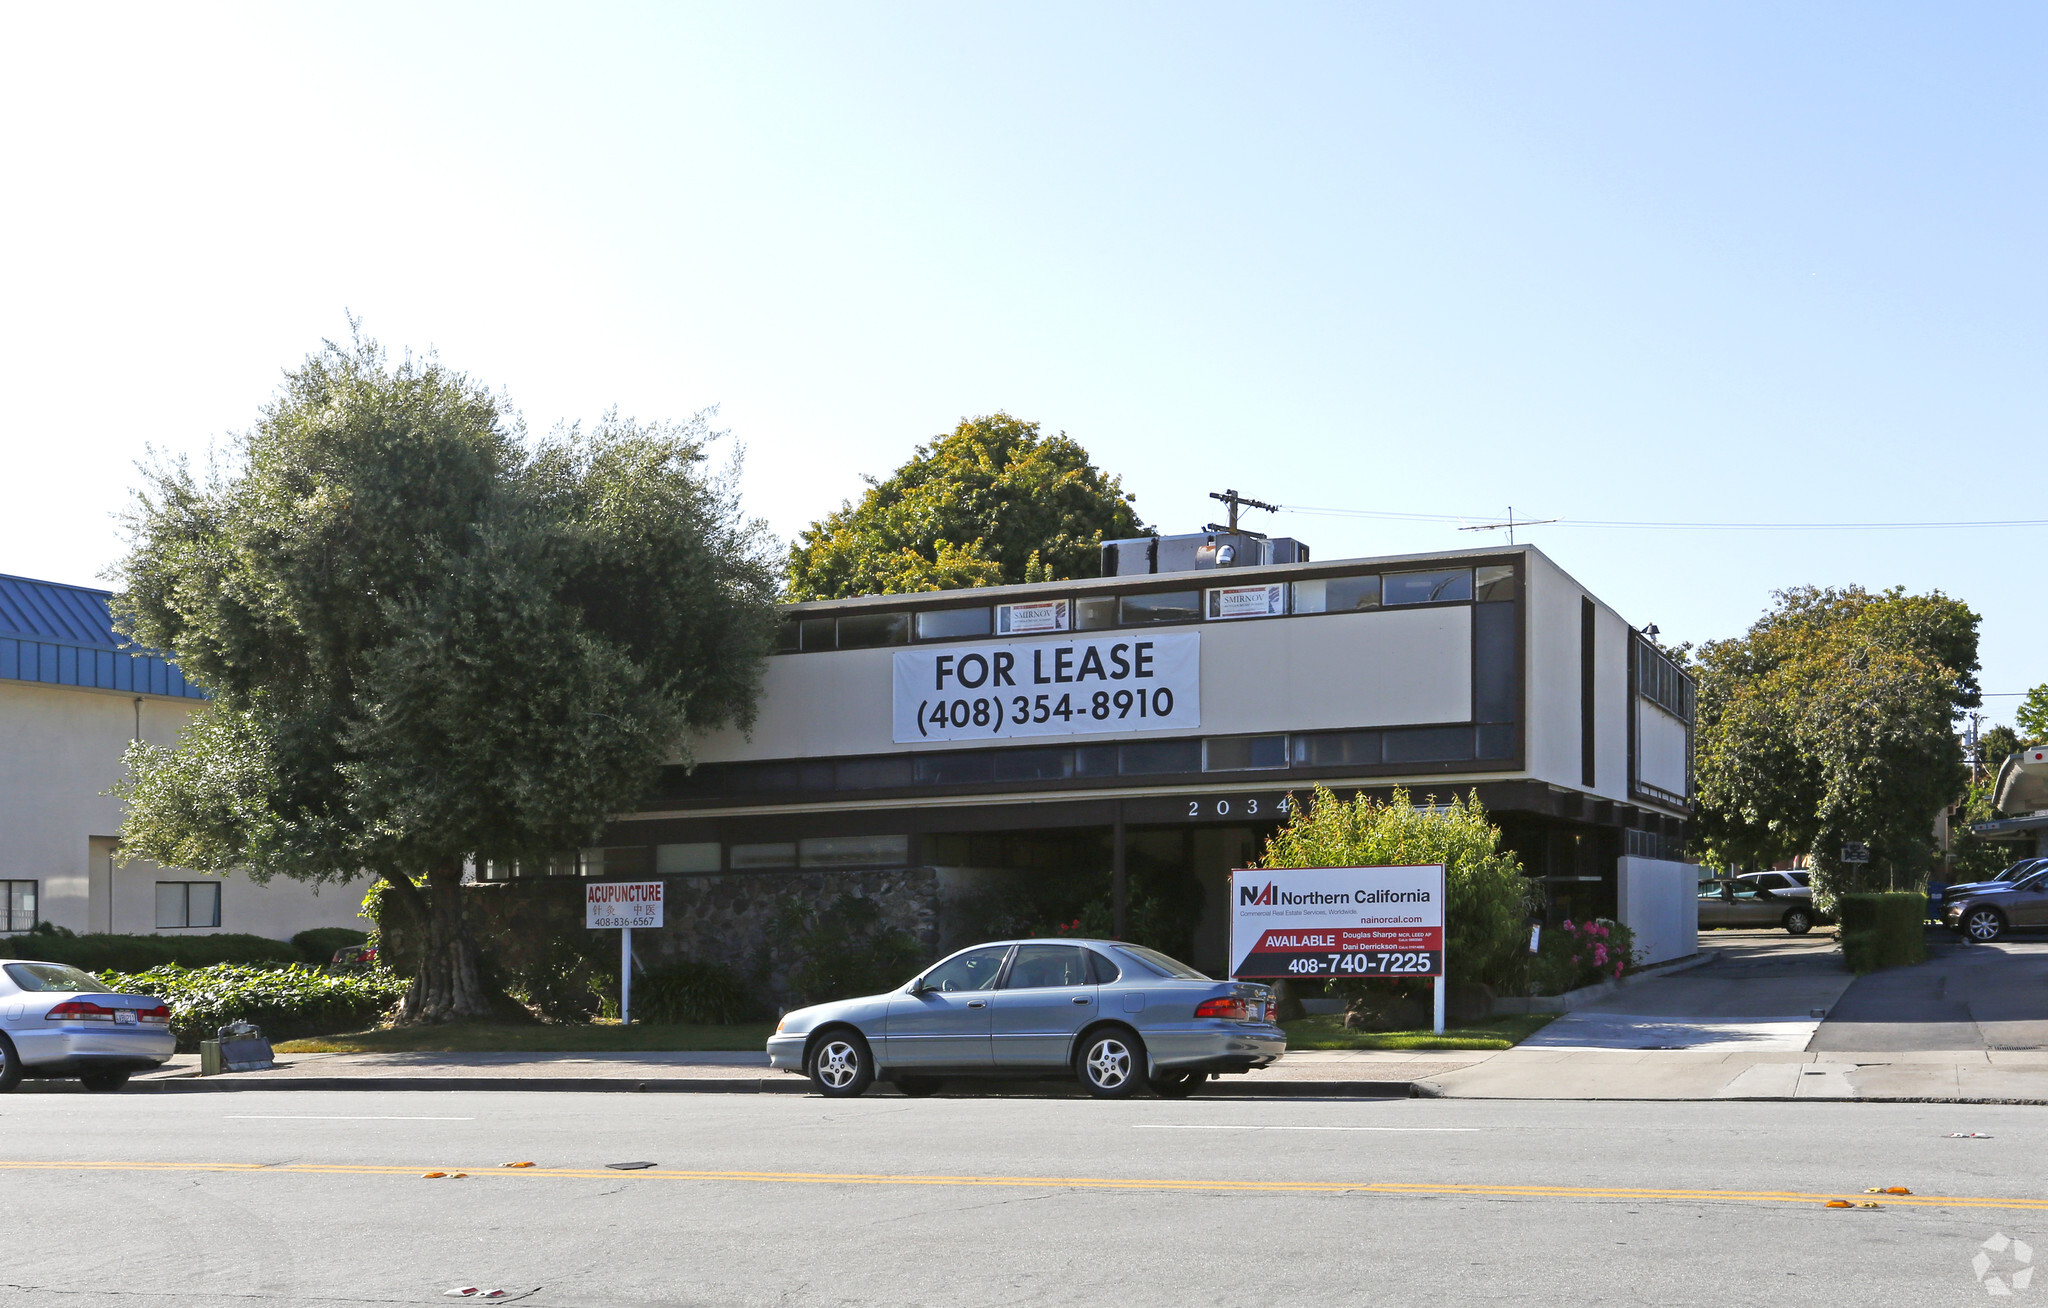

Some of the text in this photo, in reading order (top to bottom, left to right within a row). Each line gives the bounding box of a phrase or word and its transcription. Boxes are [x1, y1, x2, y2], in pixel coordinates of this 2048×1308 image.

[1224, 594, 1264, 604] SMIRNOV
[1014, 609, 1052, 619] SMIRNOV
[936, 642, 1154, 691] FOR LEASE
[917, 687, 1174, 737] (408) 354-8910
[588, 884, 662, 903] ACUPUNCTURE
[1240, 881, 1431, 906] NAI Northern California
[594, 917, 655, 927] 408-836-6567
[1360, 916, 1423, 925] nainorcal.com
[1265, 935, 1336, 948] AVAILABLE
[1342, 931, 1371, 939] Douglas
[1372, 931, 1397, 939] Sharpe
[1288, 952, 1431, 974] 408-740-7225
